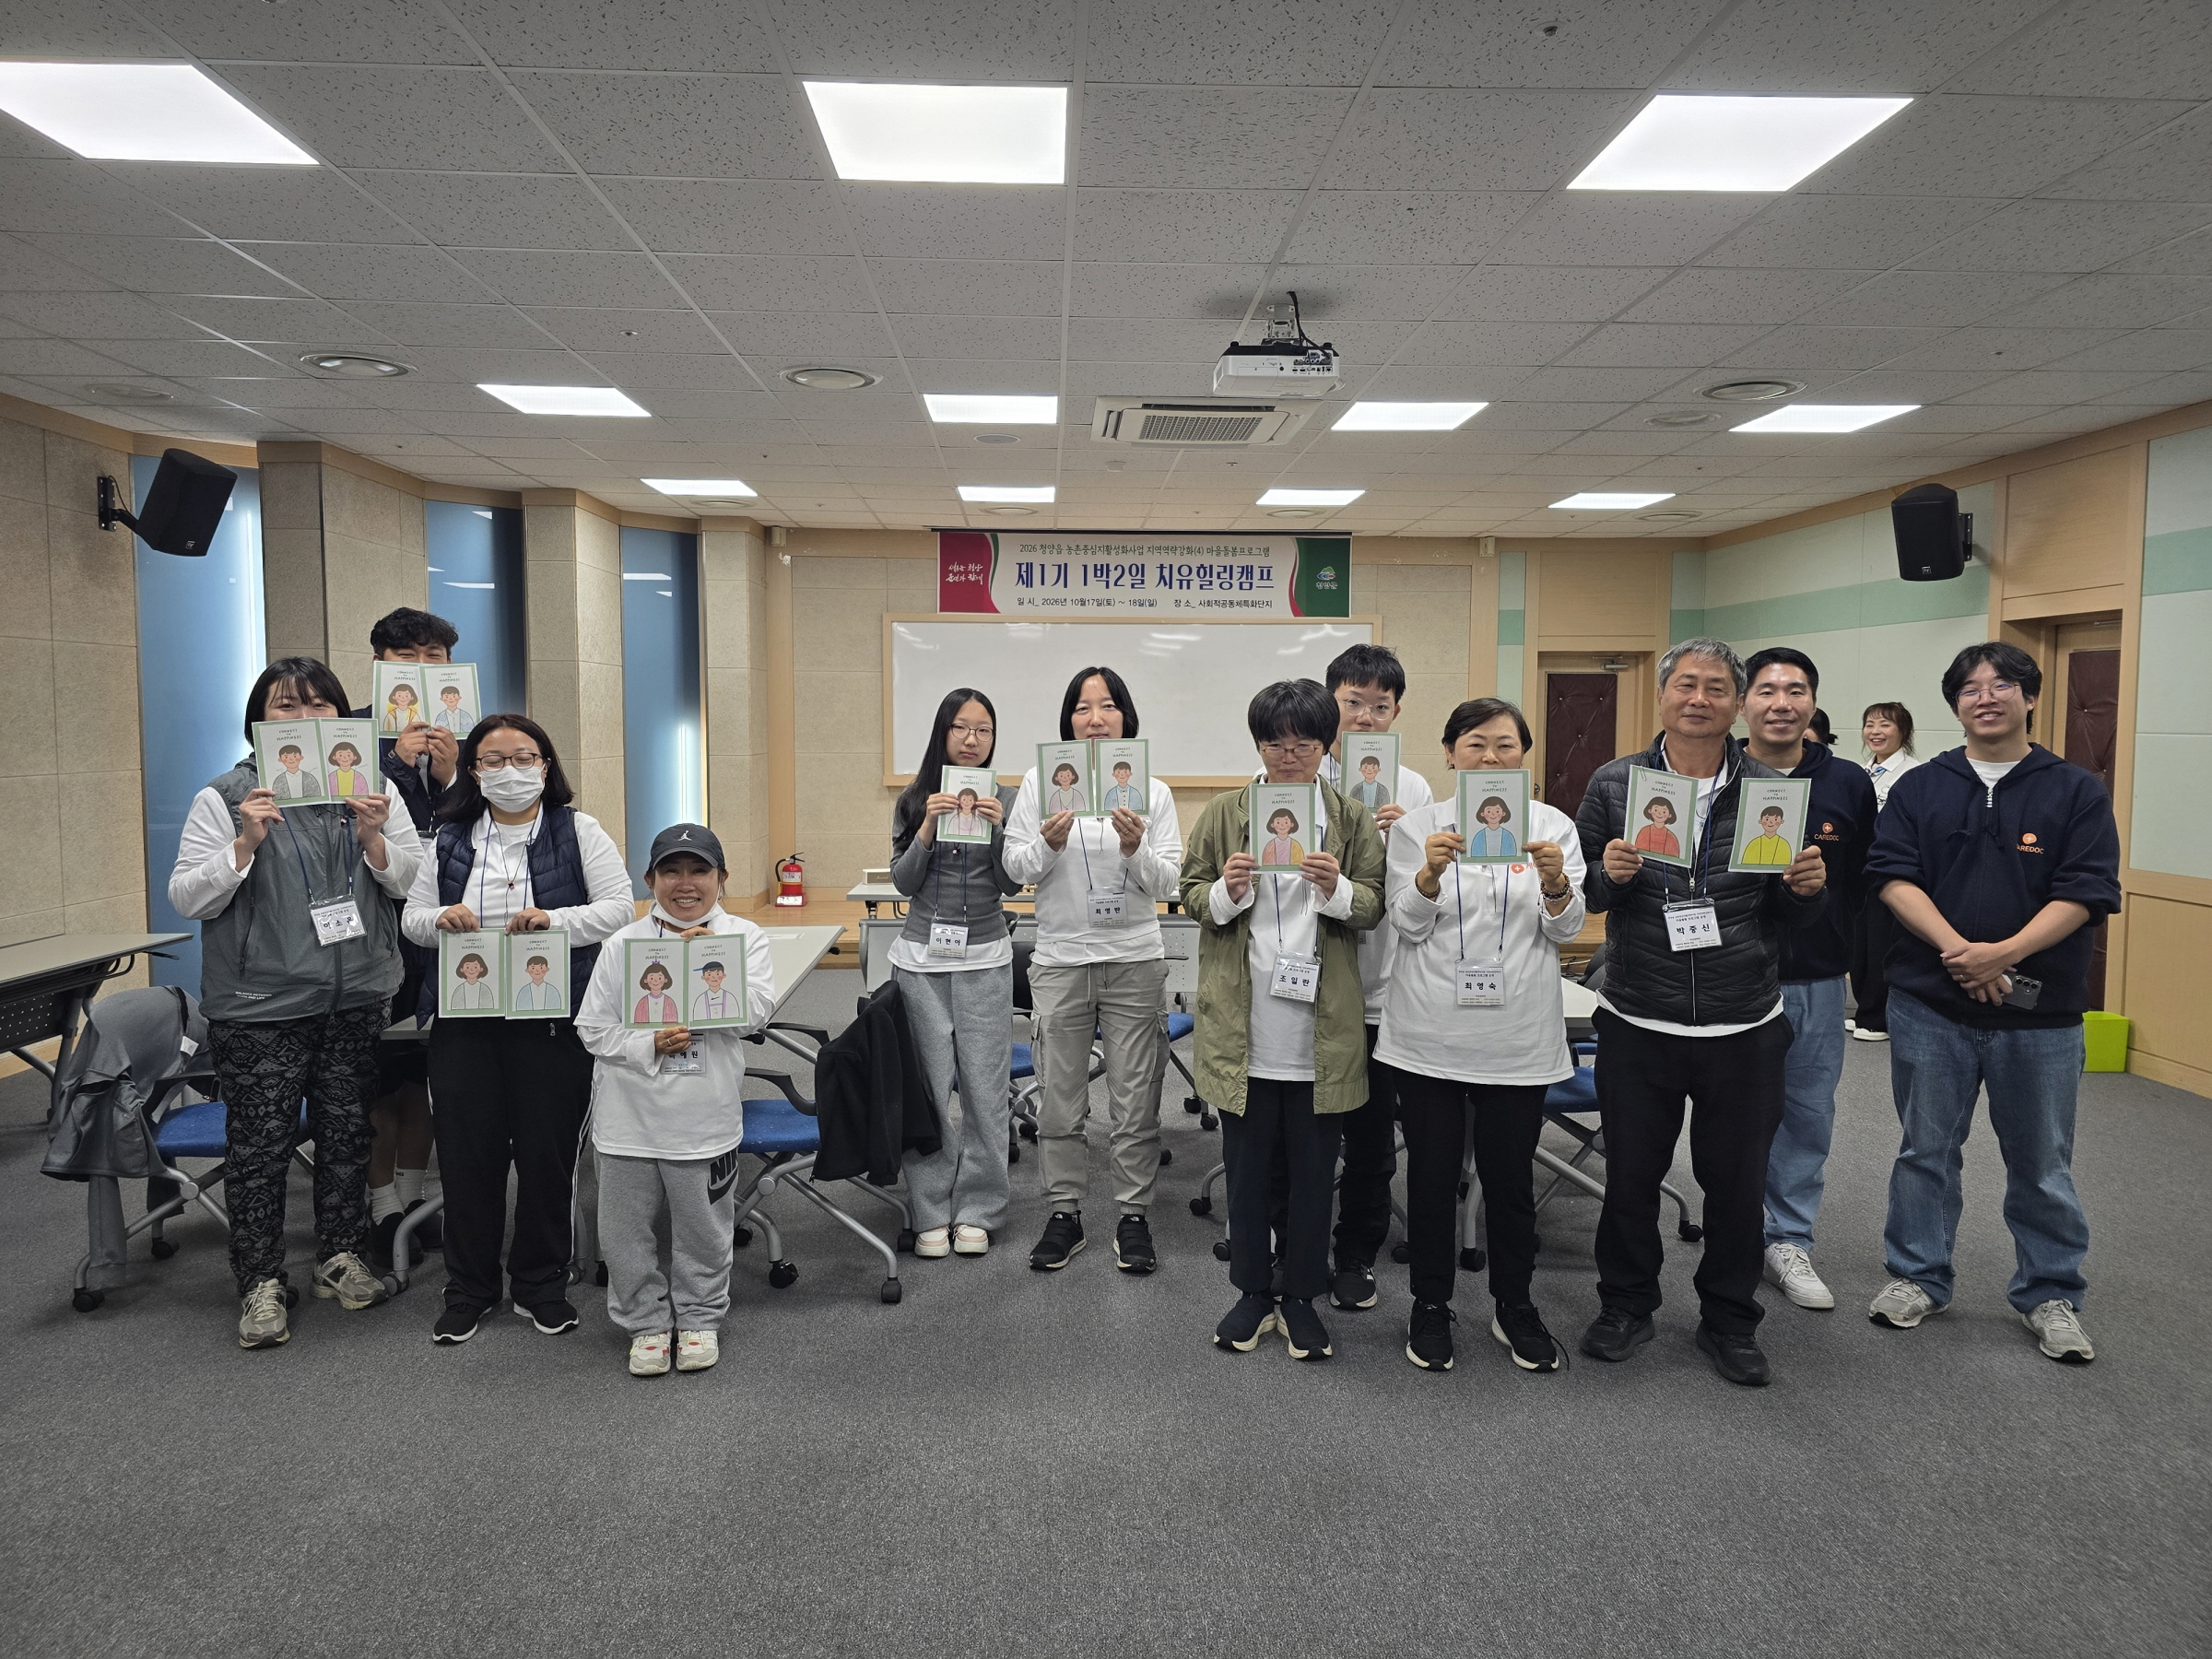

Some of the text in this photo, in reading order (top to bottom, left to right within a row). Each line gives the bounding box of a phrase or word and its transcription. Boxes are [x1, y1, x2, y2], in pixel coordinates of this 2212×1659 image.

[1019, 544, 1038, 553] 2026
[1040, 544, 1063, 555] 청양읍
[1065, 544, 1144, 556] 농촌중심지활성화사업
[1206, 546, 1270, 558] 마을돌봄프로그램
[1015, 561, 1274, 591] 제1기 1박2일 치유힐링캠프
[1041, 597, 1067, 606] 2026년
[1070, 597, 1116, 607] 10월17일(토)
[1128, 598, 1158, 607] 18일(일)
[1198, 599, 1273, 609] 사회적공동체특화단지
[1814, 833, 1840, 841] CAREDOC
[2016, 843, 2045, 854] AREDOC
